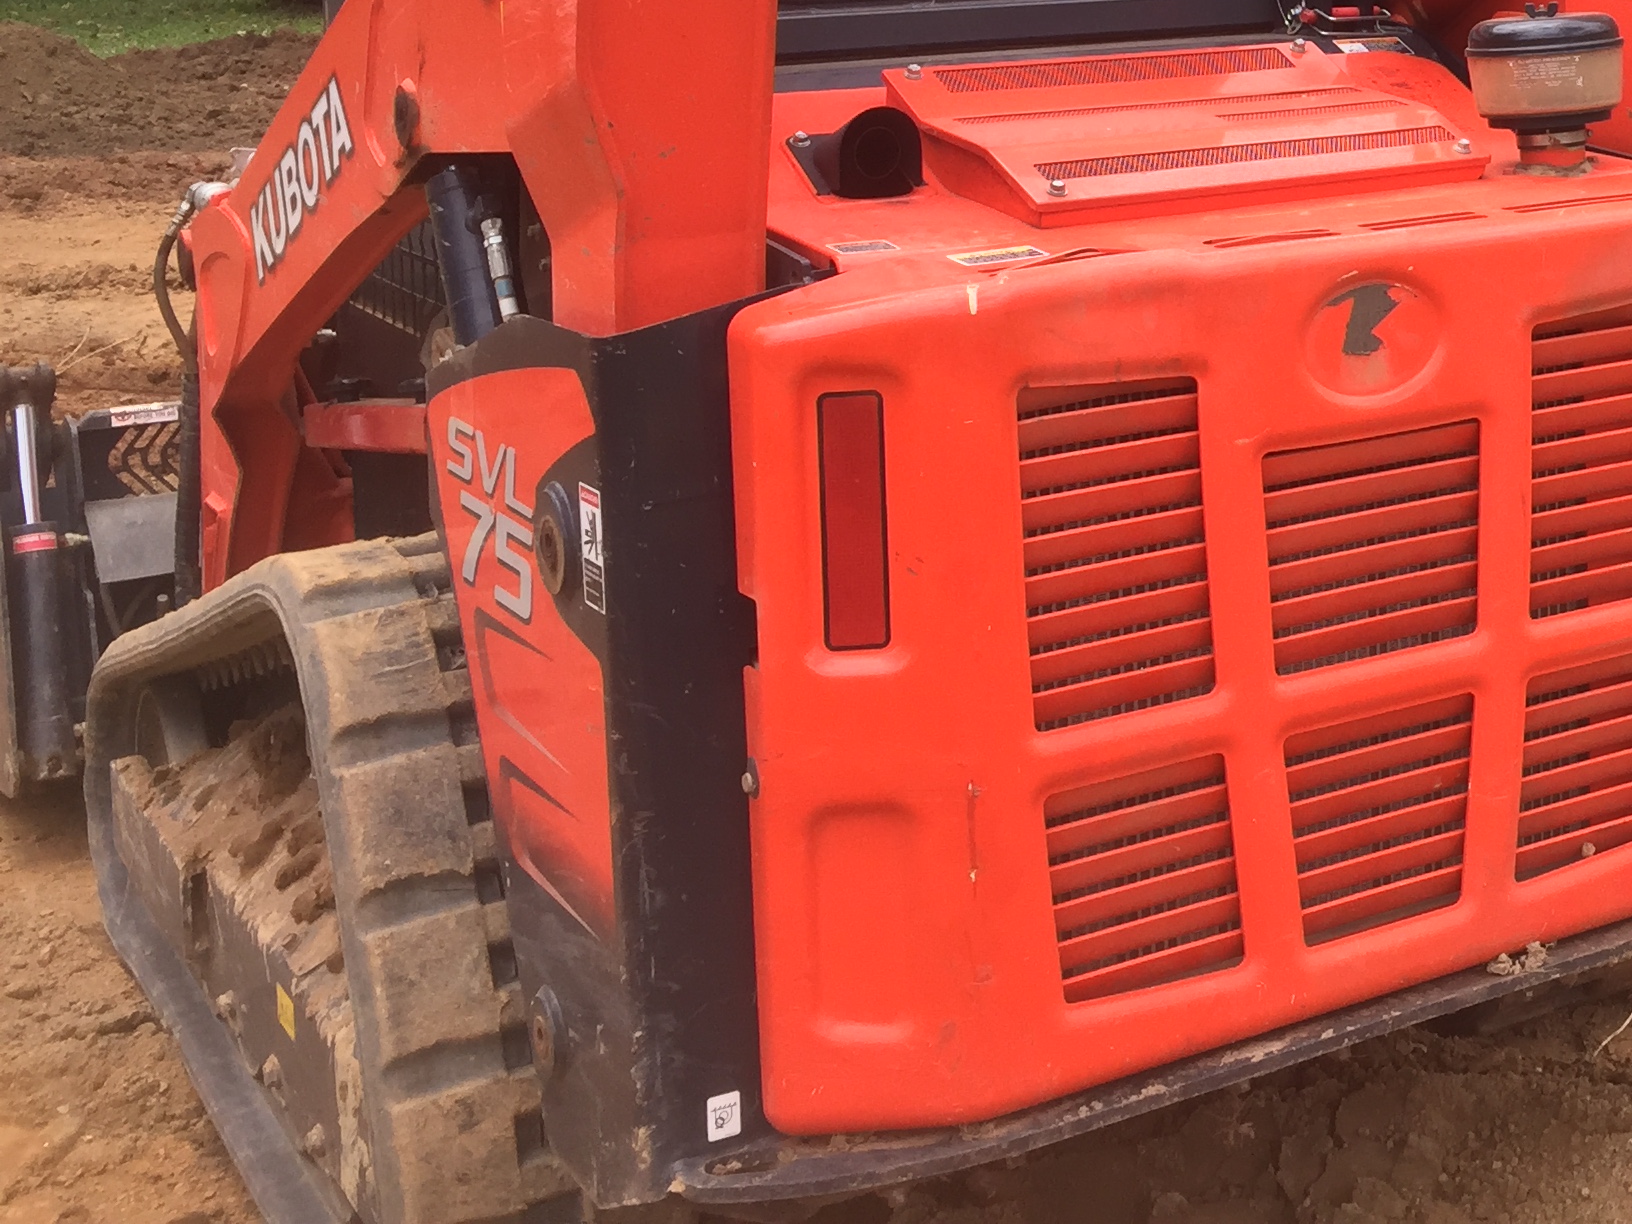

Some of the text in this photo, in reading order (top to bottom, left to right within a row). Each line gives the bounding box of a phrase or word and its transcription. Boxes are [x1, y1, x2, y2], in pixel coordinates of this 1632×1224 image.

[250, 76, 353, 282] KUBOTA
[446, 416, 535, 519] SVL
[459, 489, 534, 621] 75
